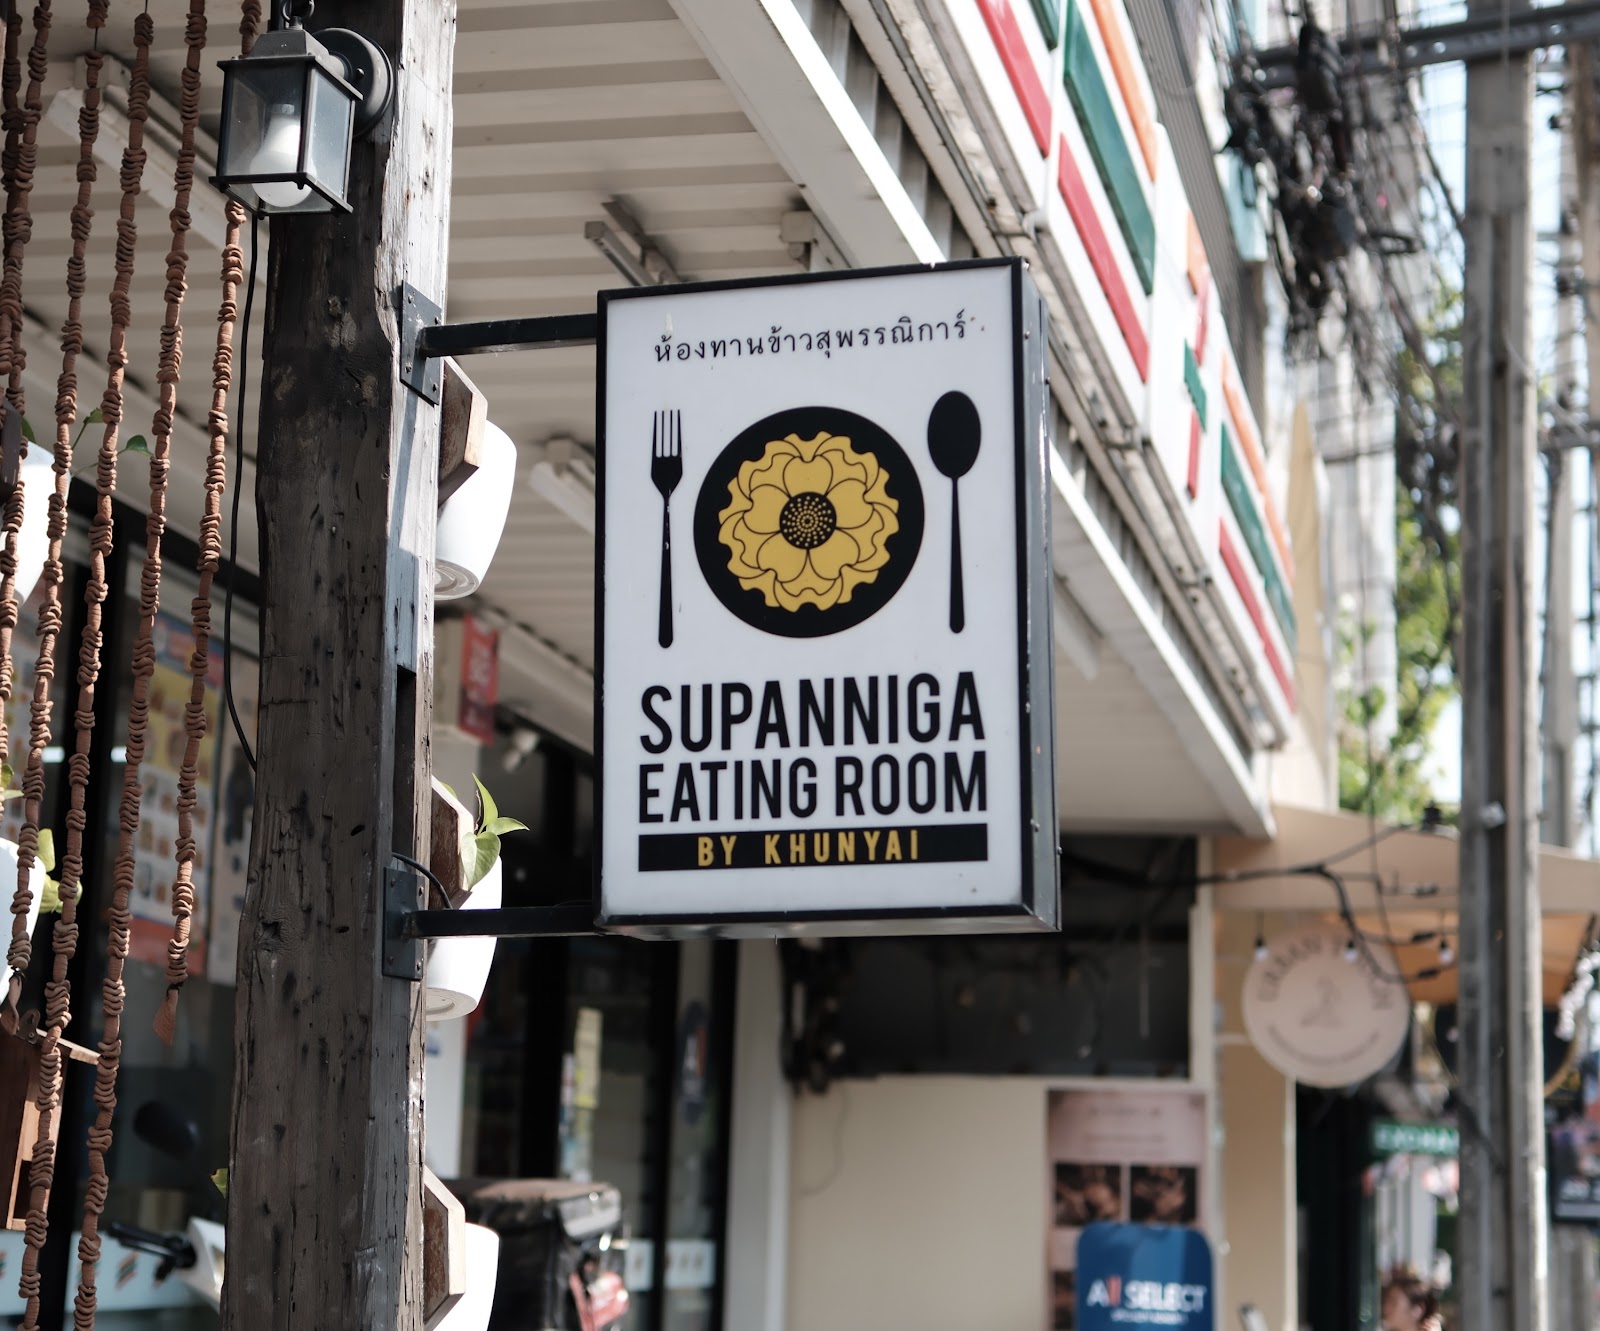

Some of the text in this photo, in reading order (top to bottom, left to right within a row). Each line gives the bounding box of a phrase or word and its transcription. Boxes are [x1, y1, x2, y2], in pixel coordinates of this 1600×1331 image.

[655, 308, 966, 363] ห้องทานข้าวสุพรรณิการ์
[640, 671, 986, 755] SUPANNIGA
[639, 750, 988, 823] EATING ROOM
[697, 829, 919, 867] BY KHUNYAI
[1123, 1279, 1208, 1314] SELECT
